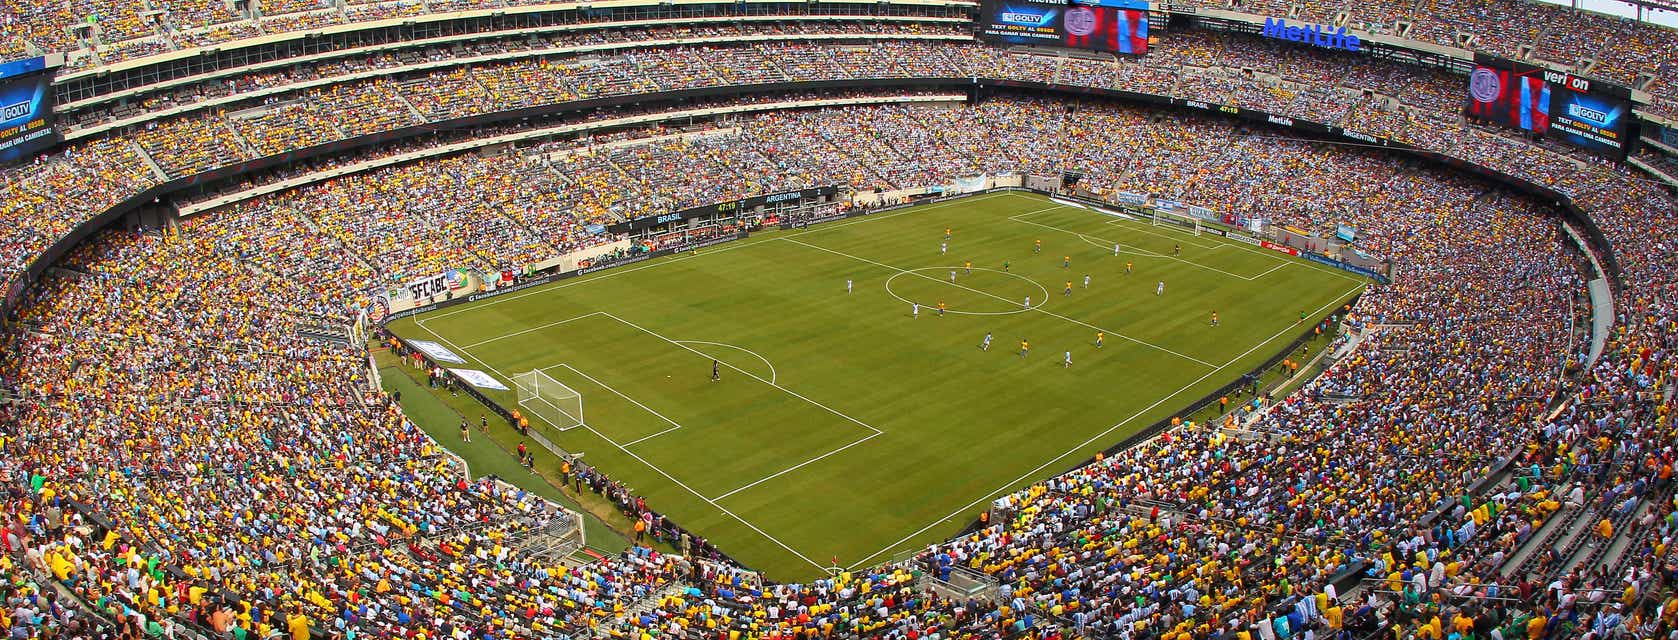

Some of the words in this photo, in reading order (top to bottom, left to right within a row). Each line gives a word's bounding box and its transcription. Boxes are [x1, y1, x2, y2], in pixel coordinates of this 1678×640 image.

[1263, 17, 1361, 51] MetLife
[1544, 71, 1589, 93] verizon
[5, 103, 29, 119] GOLTV
[1580, 109, 1604, 122] GOLTV
[20, 124, 27, 133] AL
[1186, 100, 1209, 110] BRASIL
[1268, 115, 1293, 127] MetLife
[1343, 128, 1377, 143] ARGENTINA
[1558, 117, 1572, 126] TEXT
[1573, 121, 1591, 131] GOLTV
[1551, 123, 1565, 131] PARA
[1565, 127, 1583, 137] GANAR
[13, 136, 24, 146] UNA
[657, 213, 682, 224] BRASIL
[718, 202, 736, 212] 47:19
[766, 192, 801, 204] ARGENTINA
